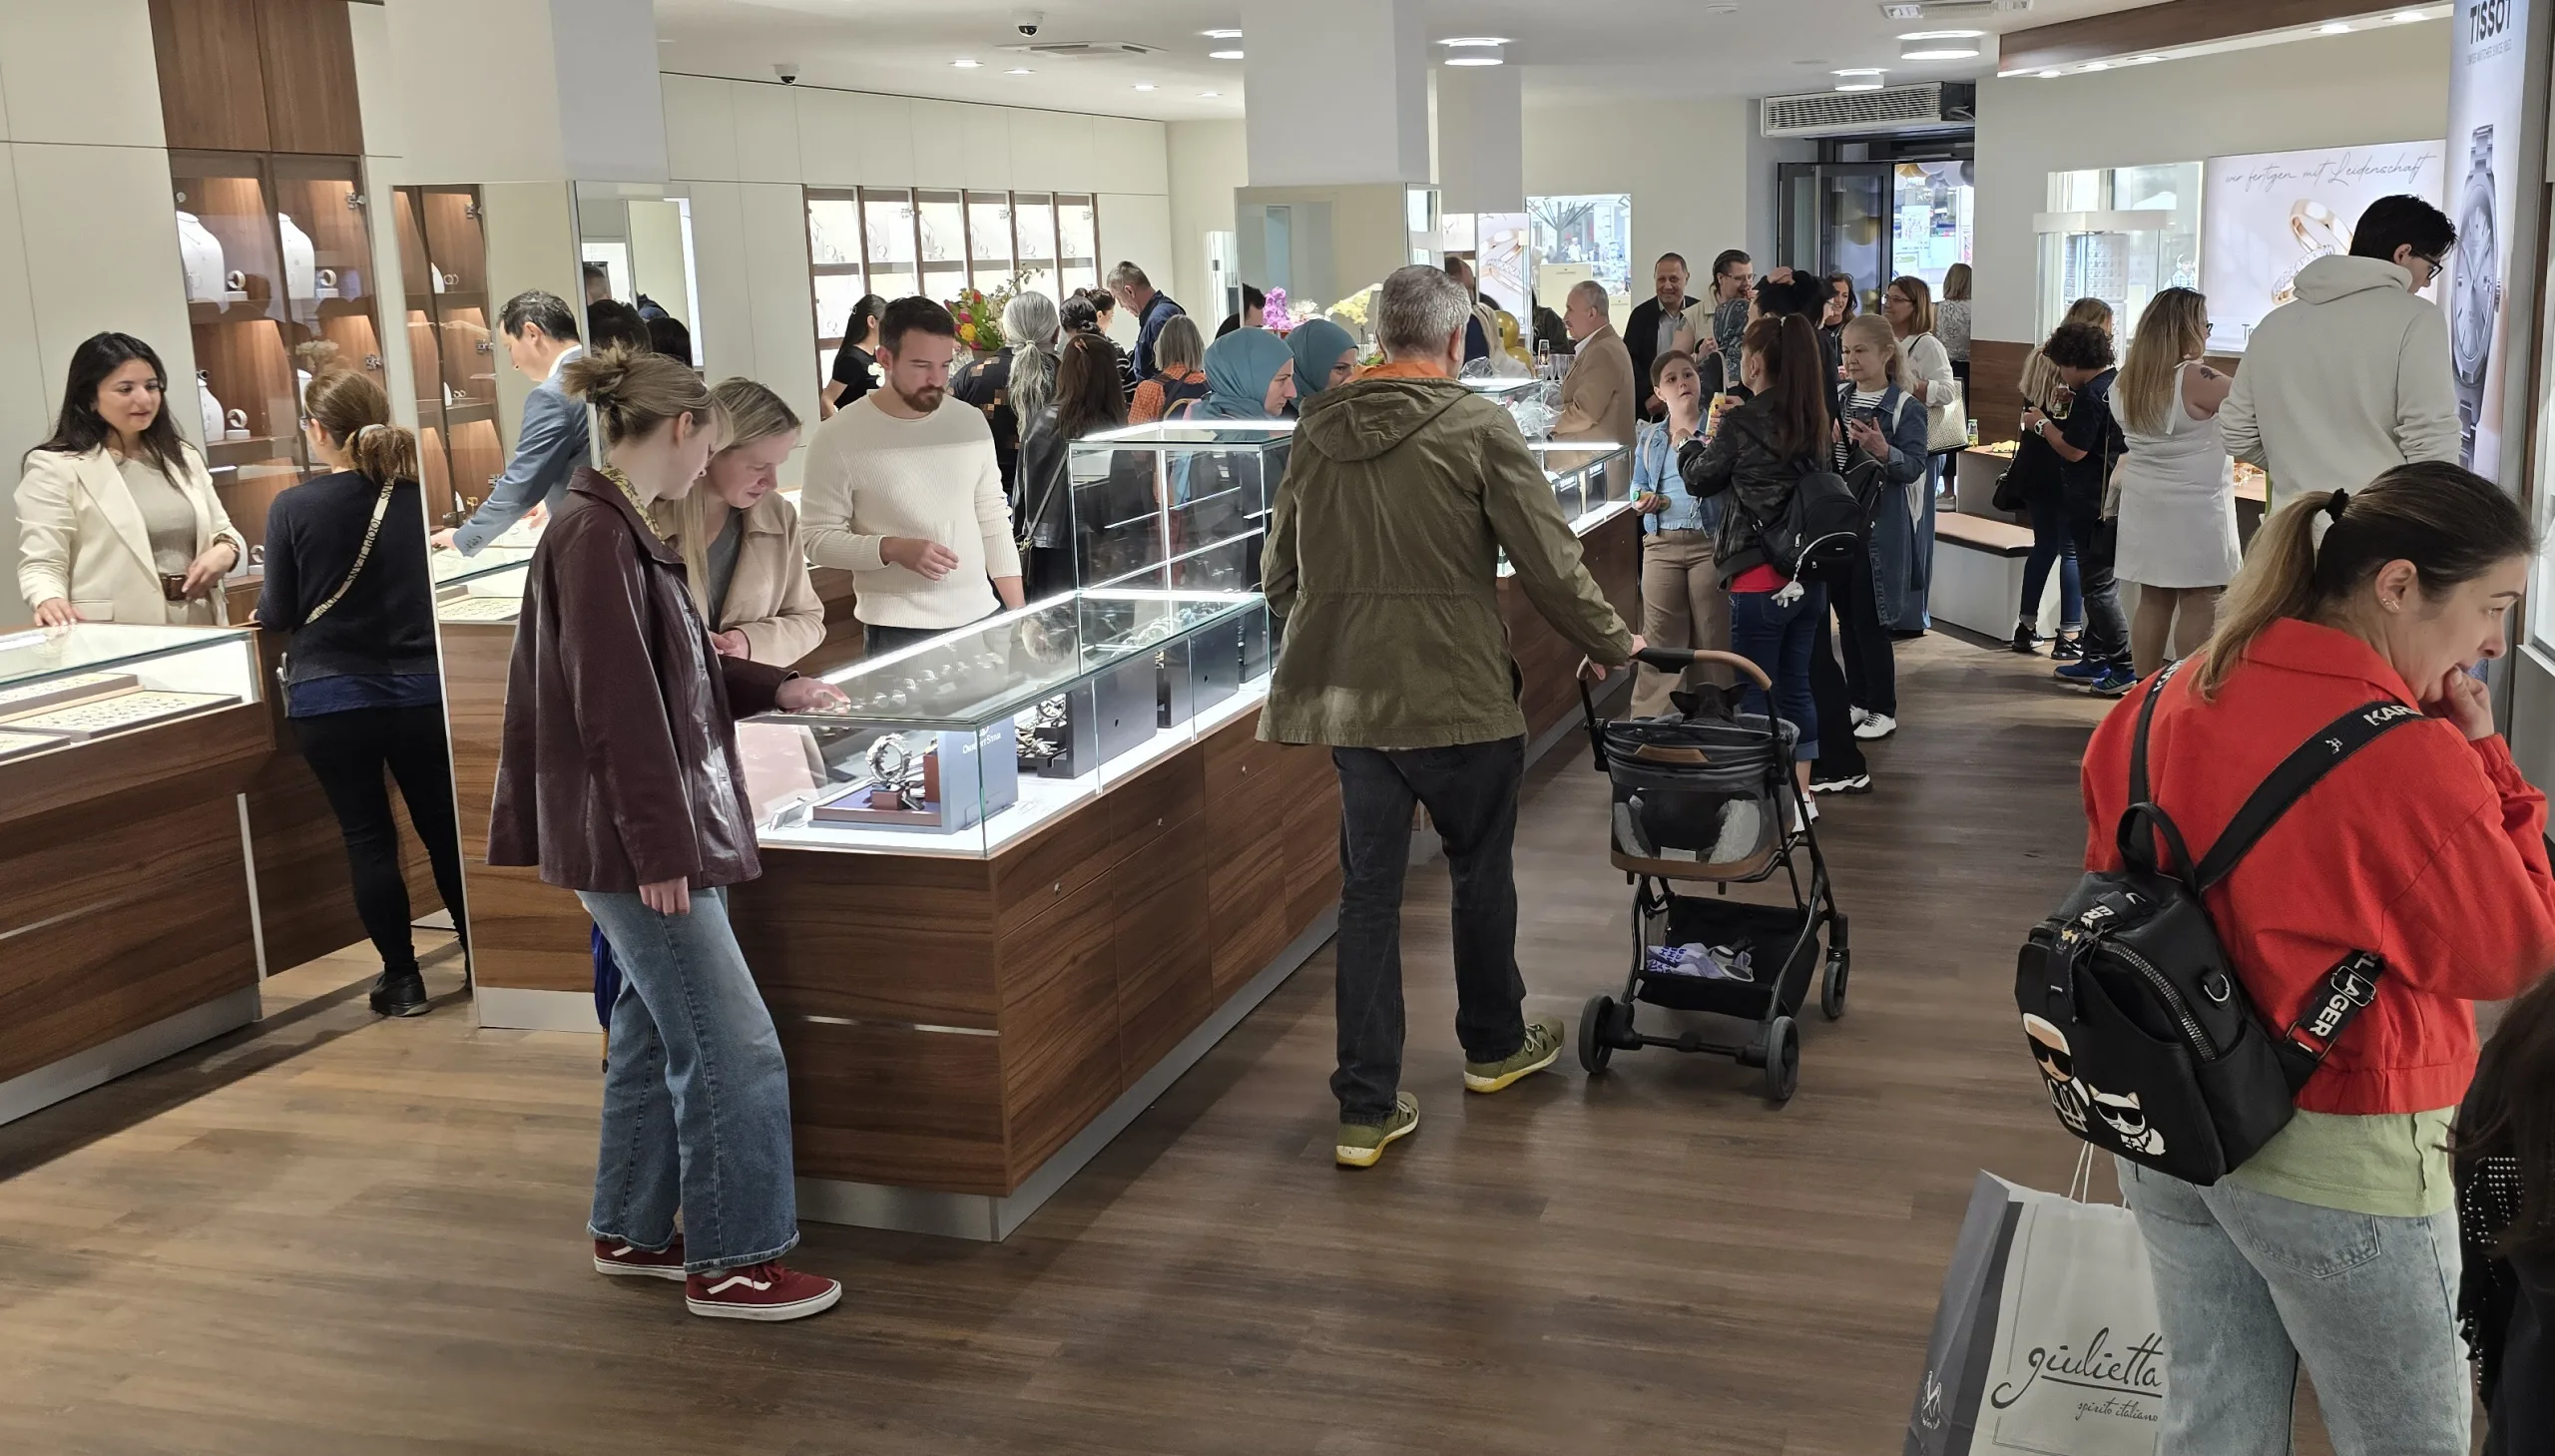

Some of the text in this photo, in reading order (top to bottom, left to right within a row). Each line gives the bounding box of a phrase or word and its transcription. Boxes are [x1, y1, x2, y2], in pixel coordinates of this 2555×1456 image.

[2469, 0, 2511, 45] TISSOT
[2225, 151, 2438, 193] wir fertigen mit Leidenschaft
[1990, 1326, 2164, 1409] giulietta
[2074, 1396, 2159, 1422] spirito italiano
